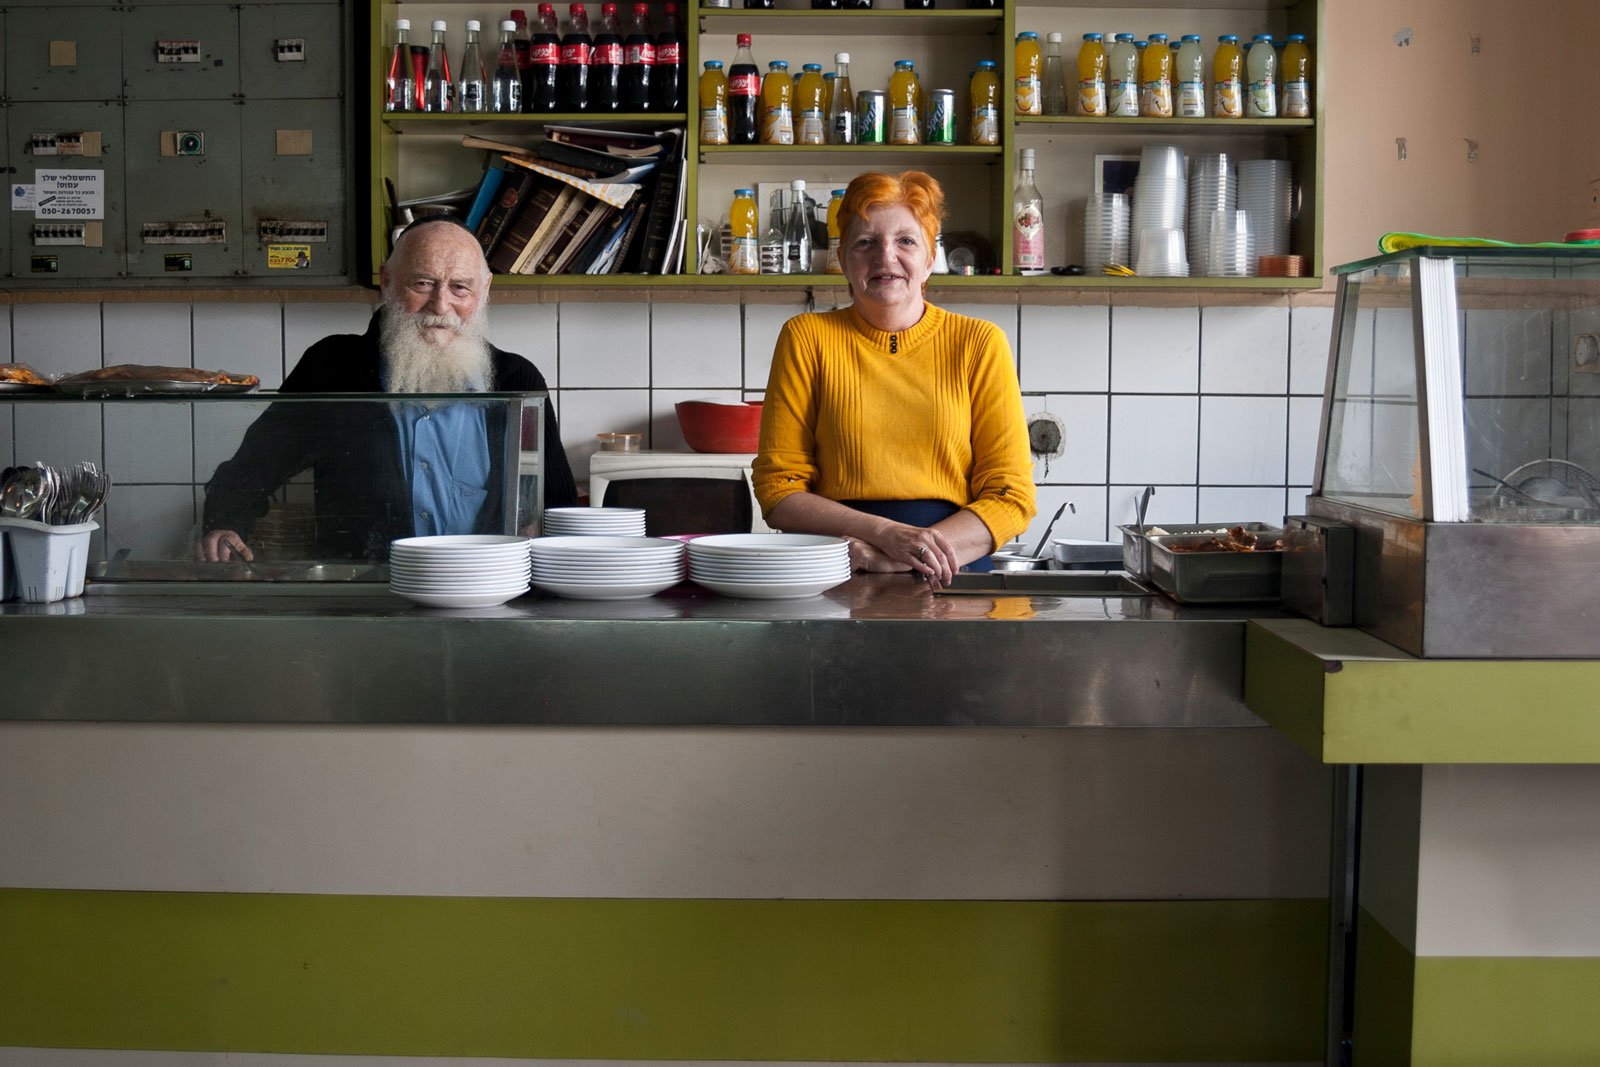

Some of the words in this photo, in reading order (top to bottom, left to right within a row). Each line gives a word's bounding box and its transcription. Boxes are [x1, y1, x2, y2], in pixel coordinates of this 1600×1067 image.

[859, 101, 877, 136] Sprit
[926, 100, 945, 136] Sprit
[42, 207, 95, 215] 050-2670057
